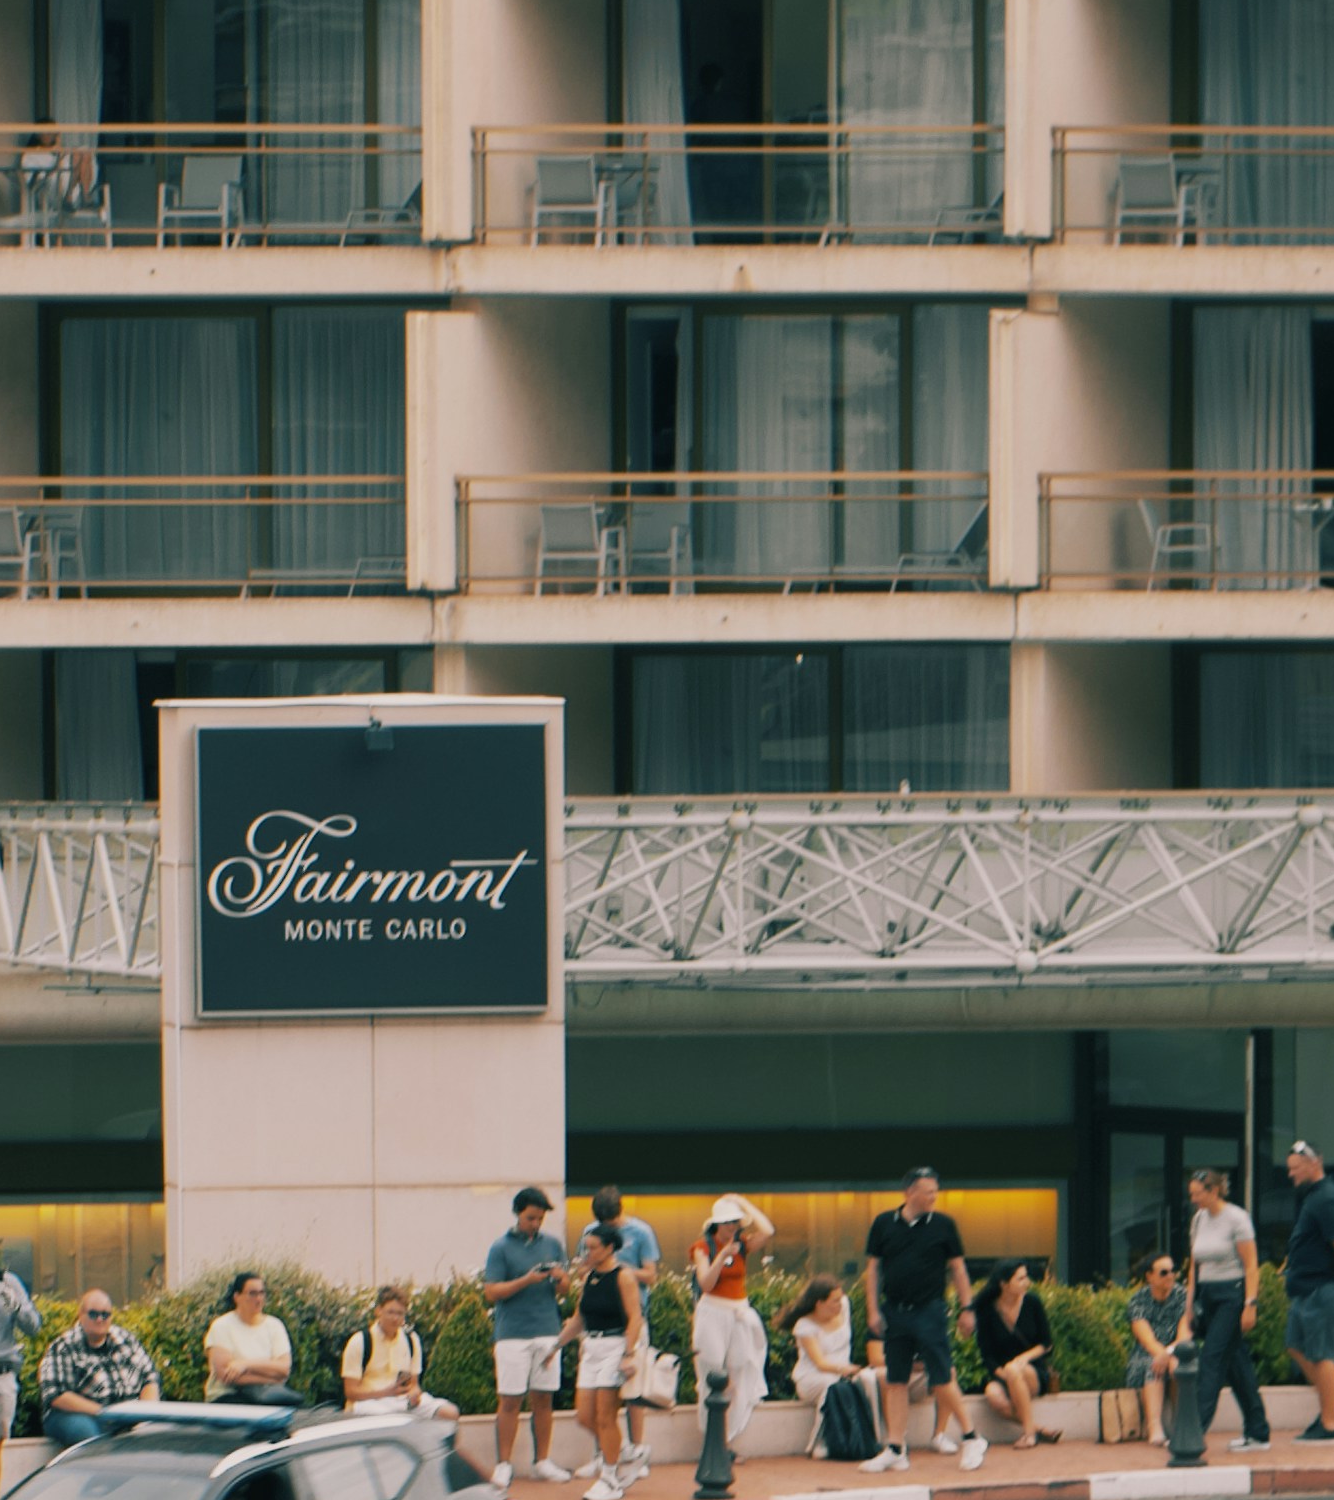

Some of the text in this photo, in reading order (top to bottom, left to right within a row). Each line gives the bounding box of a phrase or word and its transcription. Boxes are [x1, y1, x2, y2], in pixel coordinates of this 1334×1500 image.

[206, 809, 538, 919] Fairmont
[284, 917, 467, 942] MONTE CARLO
